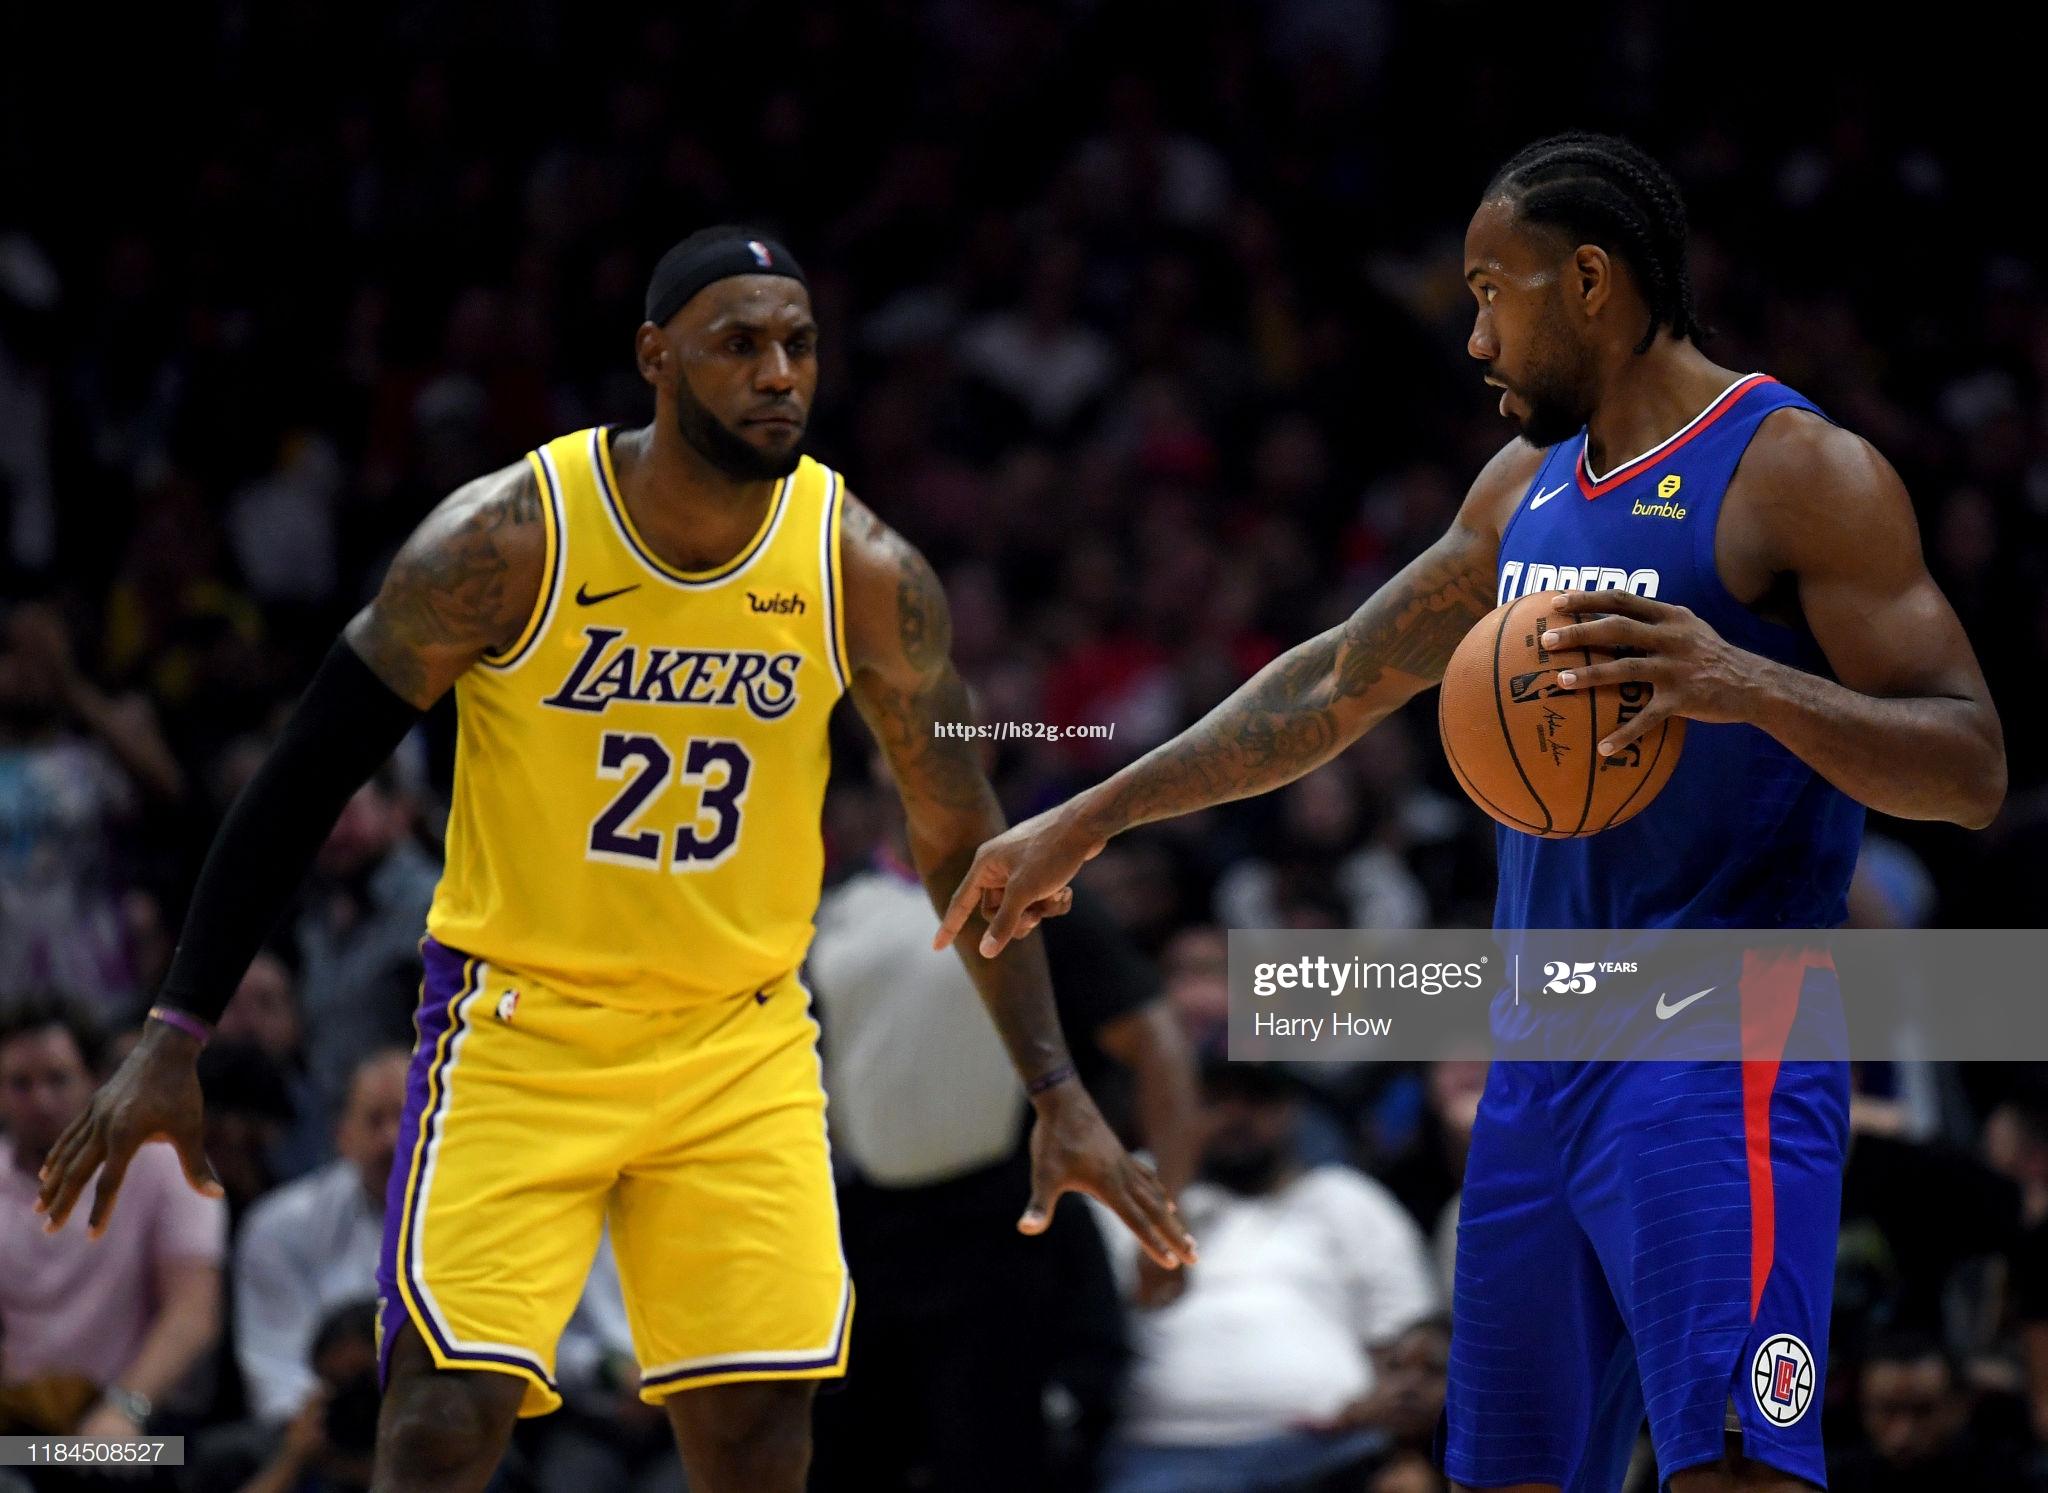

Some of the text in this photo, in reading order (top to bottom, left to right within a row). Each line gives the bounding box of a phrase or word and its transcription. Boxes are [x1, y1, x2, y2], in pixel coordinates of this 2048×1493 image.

[1632, 499, 1686, 520] bumble
[746, 591, 806, 615] wish
[541, 626, 802, 720] LAKERS
[586, 730, 752, 875] 23
